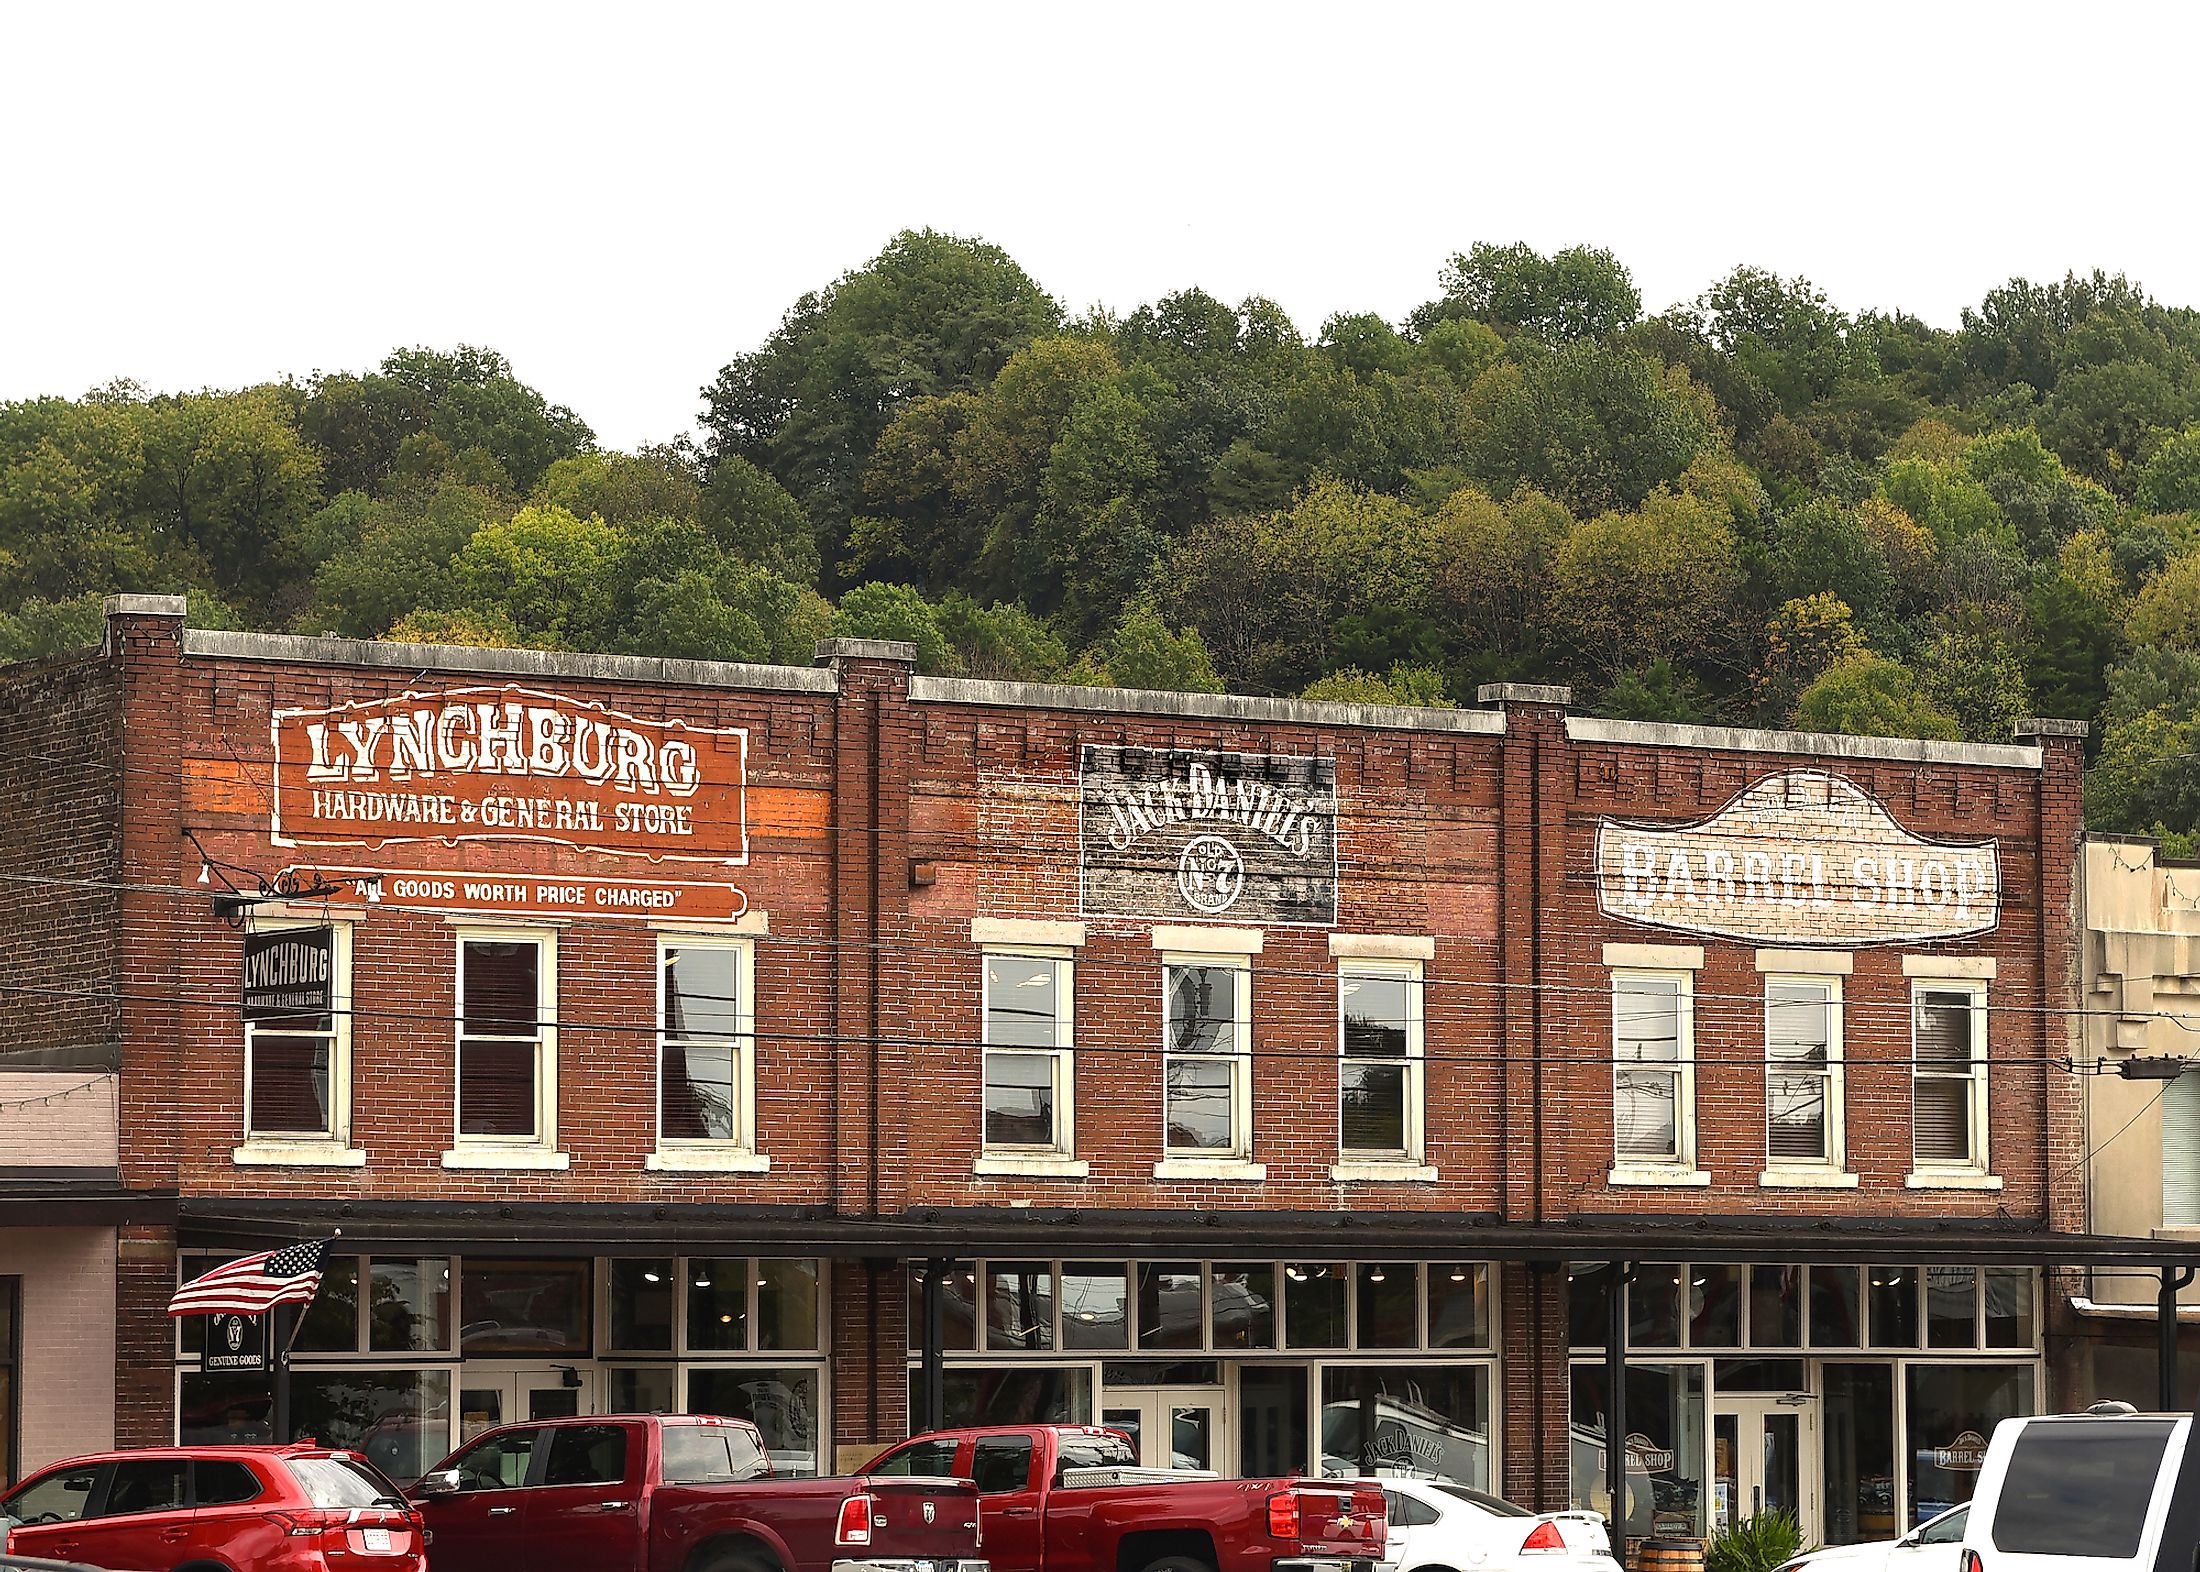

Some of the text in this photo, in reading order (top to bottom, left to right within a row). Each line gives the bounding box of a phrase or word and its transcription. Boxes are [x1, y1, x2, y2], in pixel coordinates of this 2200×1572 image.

[306, 702, 701, 797] LYNCHBURG
[312, 789, 694, 836] HARDWARE & GENERAL STORE
[1104, 777, 1189, 851] JACK
[1198, 842, 1223, 857] OLD
[393, 879, 455, 900] GOODS
[463, 883, 527, 903] WORTH
[536, 885, 586, 904] PRICE
[1621, 841, 1985, 921] BARREL SHOP
[245, 943, 328, 989] LYNCHBURG
[209, 1354, 262, 1367] GENUINE GOODS
[1363, 1428, 1446, 1467] JACK DANIEL'S
[1644, 1452, 1672, 1469] SHOP
[1939, 1450, 1975, 1466] BARREL
